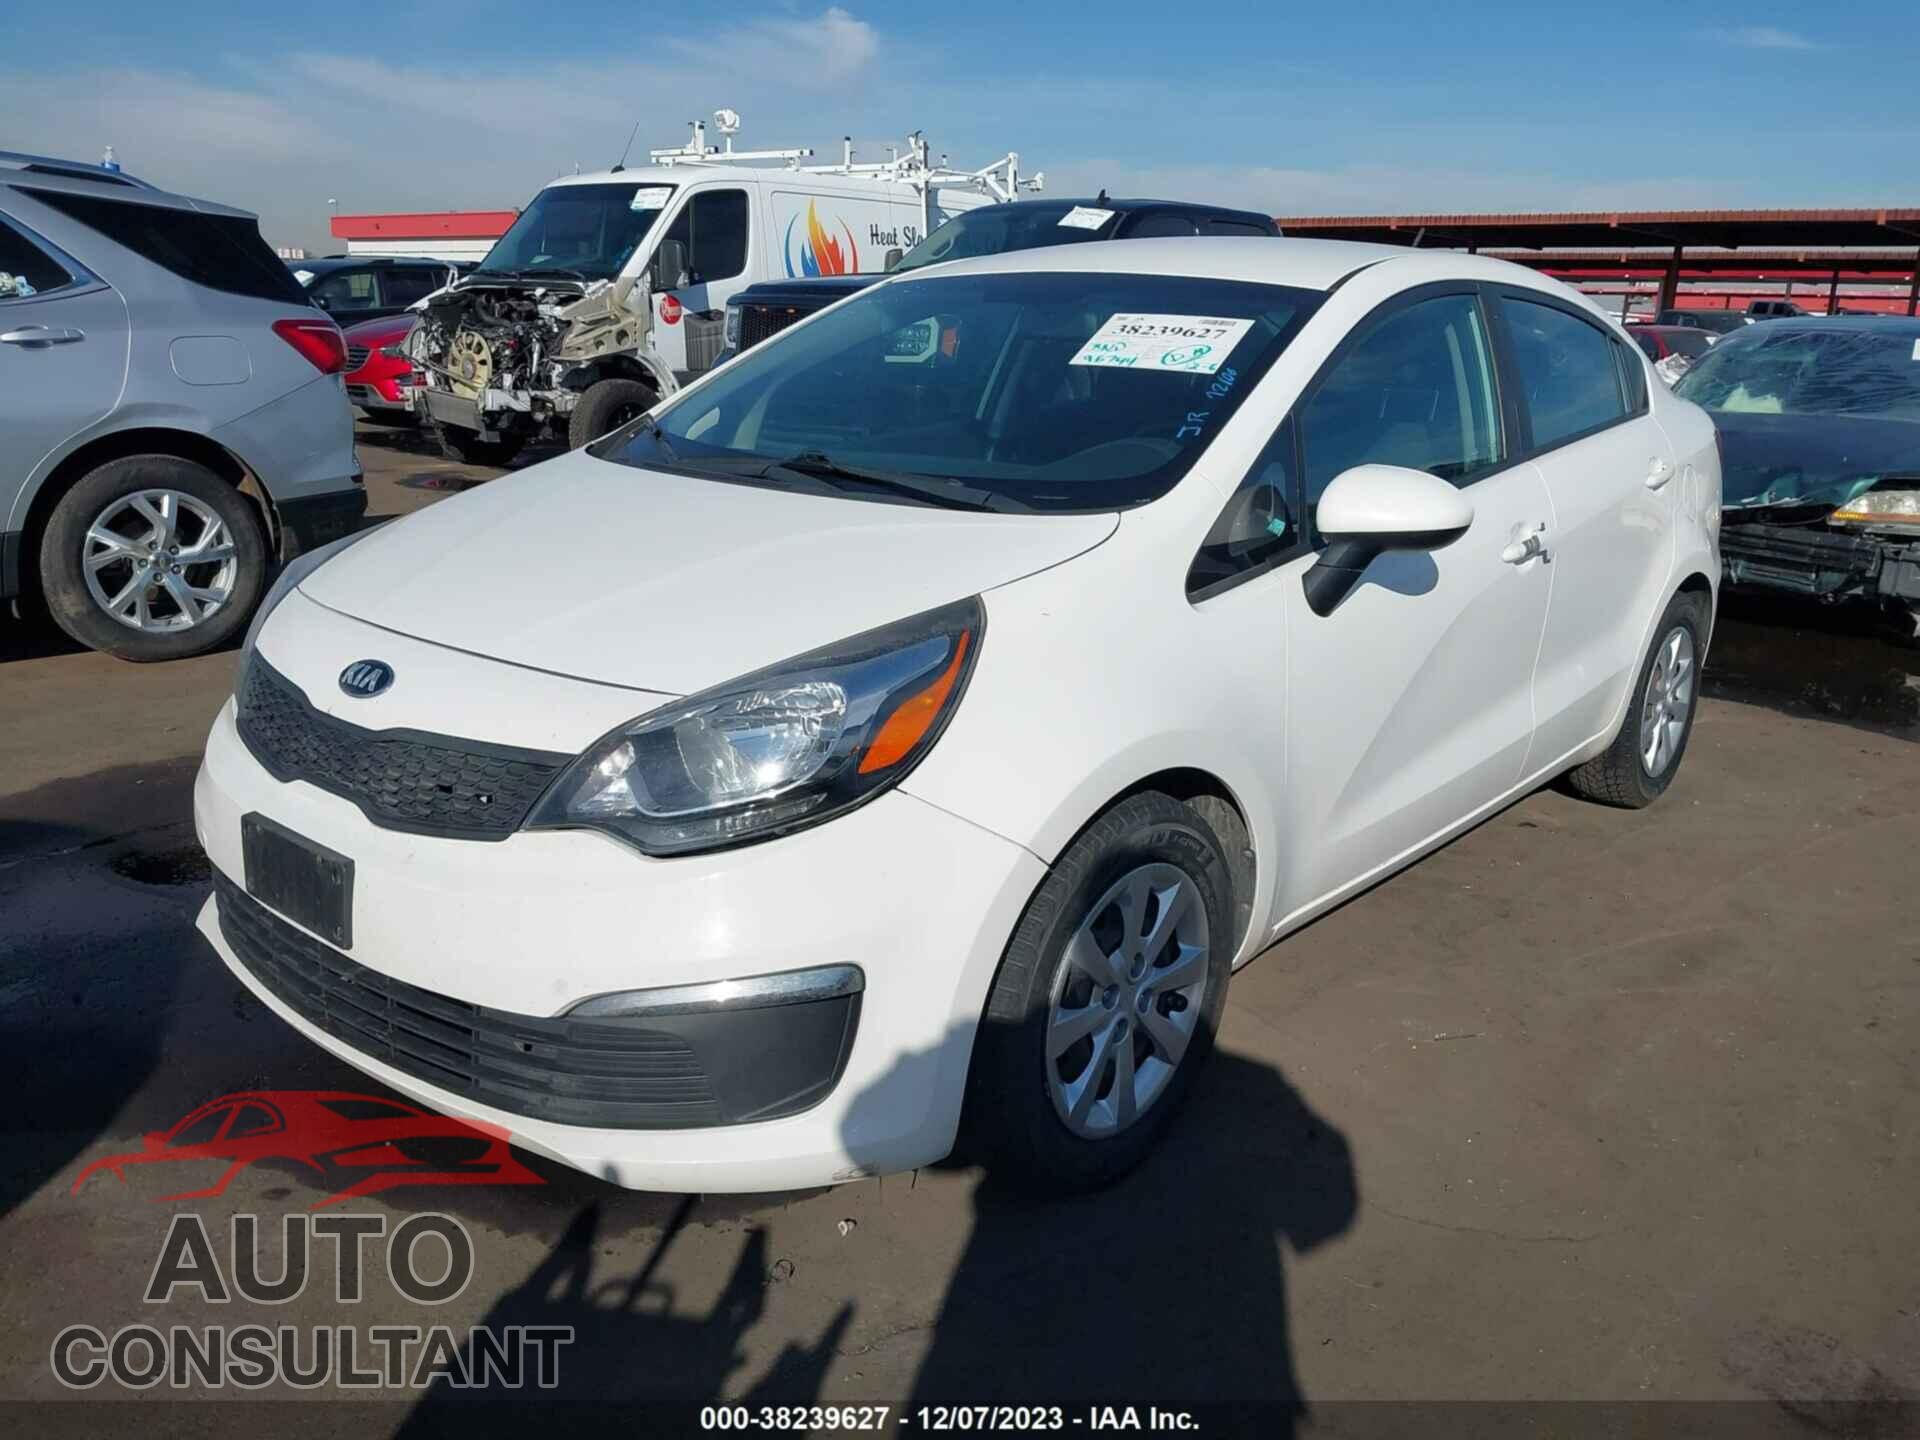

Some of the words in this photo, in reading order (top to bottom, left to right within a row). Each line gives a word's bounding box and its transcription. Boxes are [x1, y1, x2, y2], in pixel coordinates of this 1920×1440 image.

[870, 223, 898, 246] Heat
[1112, 324, 1227, 339] 38239627
[341, 663, 383, 692] KIA
